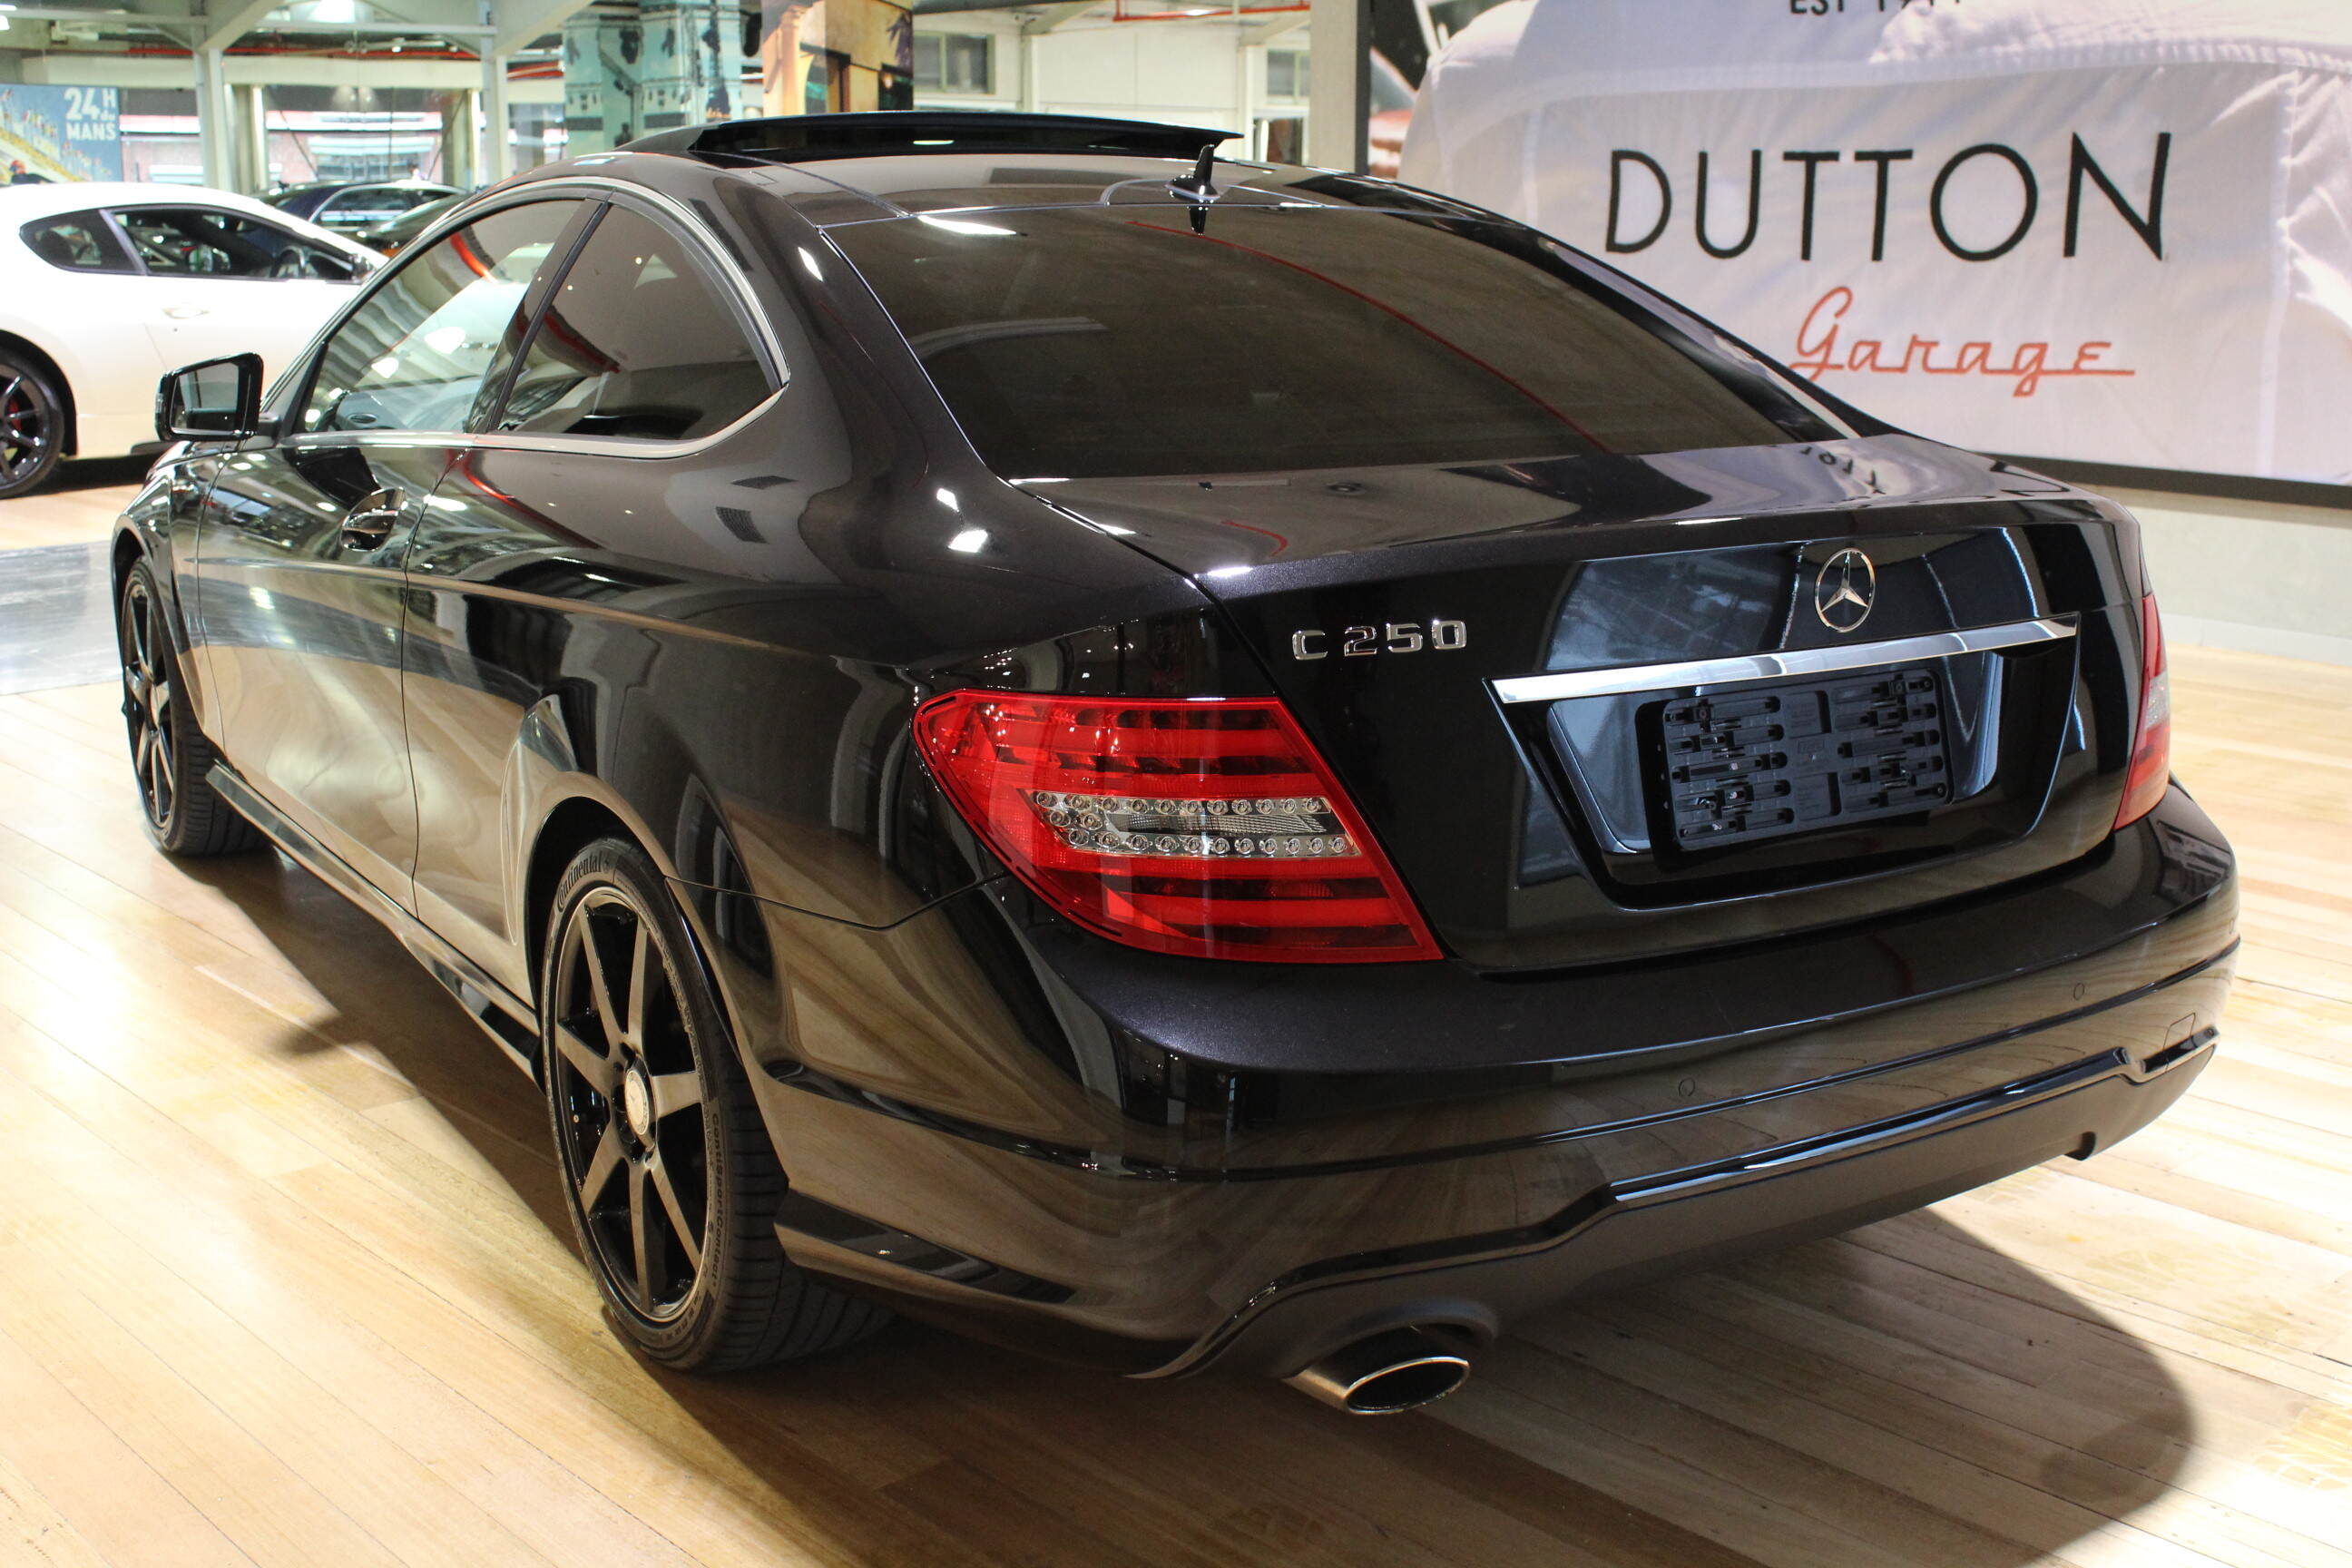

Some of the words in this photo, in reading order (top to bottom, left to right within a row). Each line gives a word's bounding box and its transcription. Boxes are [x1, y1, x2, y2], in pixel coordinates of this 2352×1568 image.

[64, 86, 100, 122] 24
[102, 86, 117, 108] H
[65, 122, 117, 142] MANS
[1604, 131, 2172, 261] DUTTON
[1788, 285, 2136, 398] Garage
[1291, 629, 1328, 661] C
[1344, 620, 1467, 657] 250
[557, 849, 603, 913] Continental
